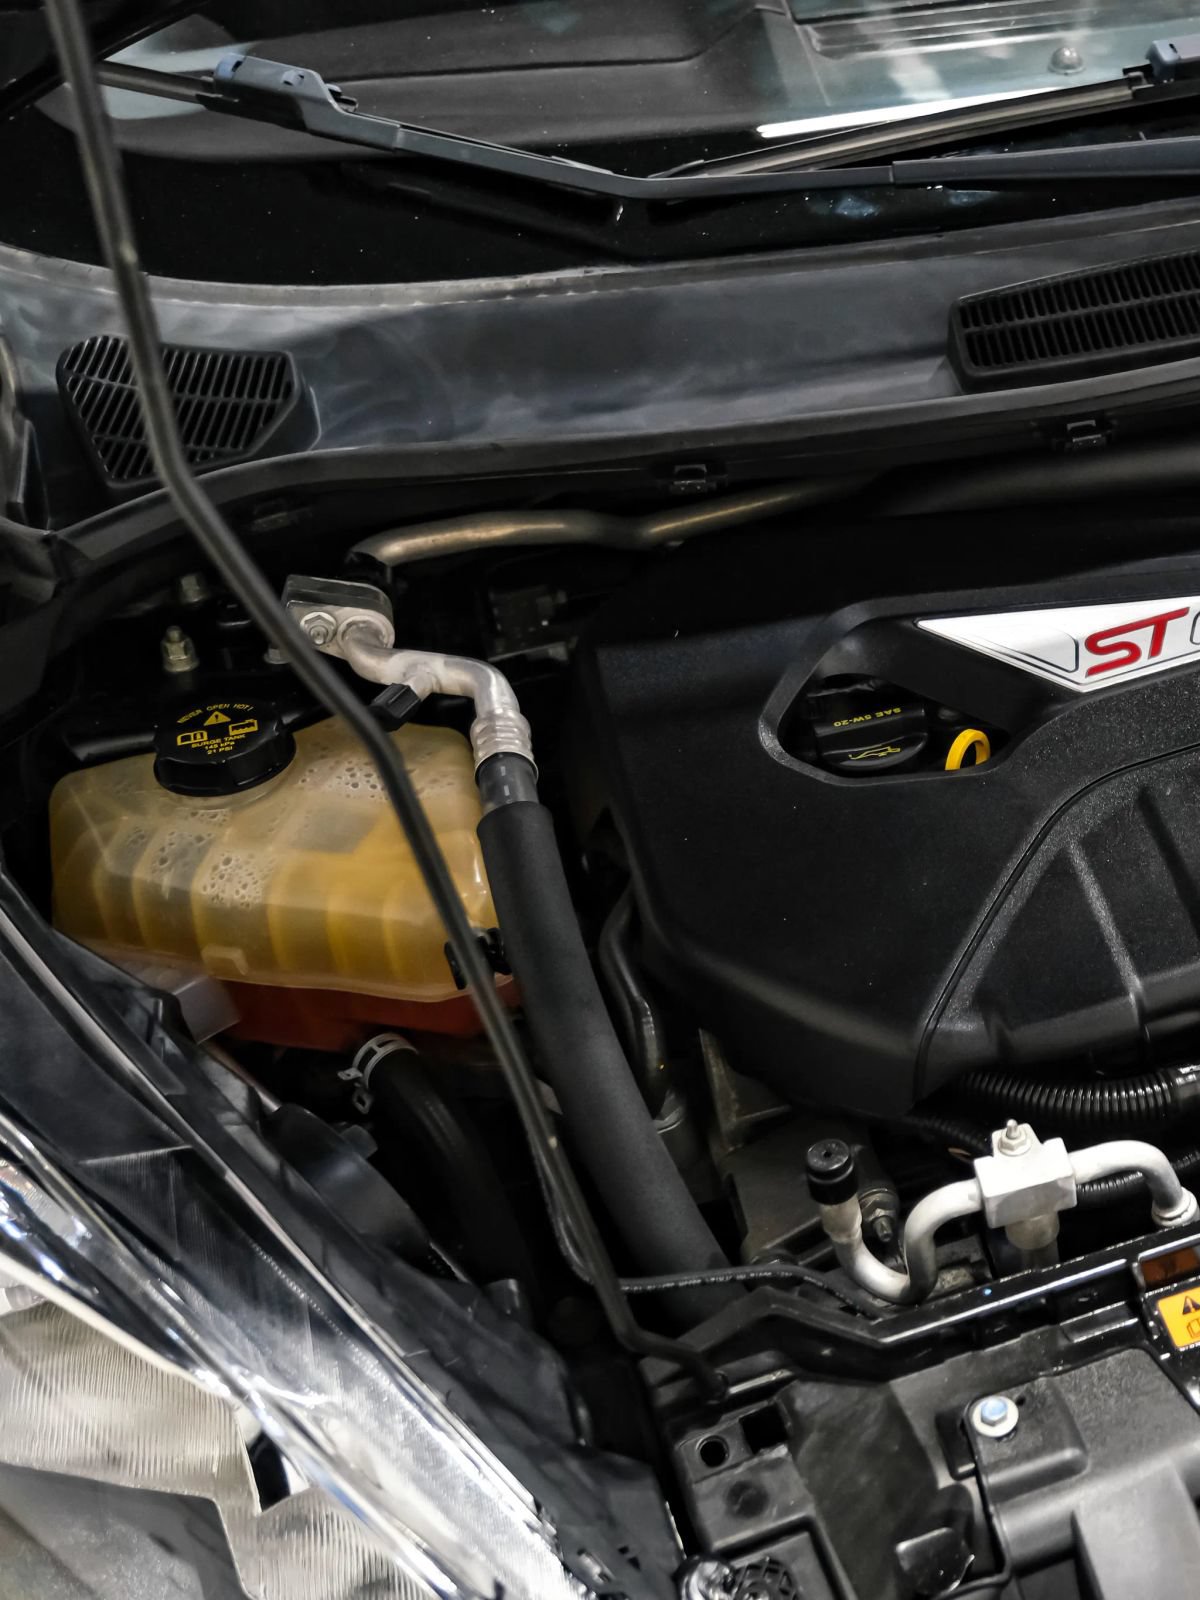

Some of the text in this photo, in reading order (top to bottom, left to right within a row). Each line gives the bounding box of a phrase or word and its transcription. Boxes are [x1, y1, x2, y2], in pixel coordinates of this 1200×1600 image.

[1085, 606, 1190, 678] ST
[206, 703, 230, 711] OPEN
[233, 703, 254, 711] HOT!
[833, 707, 902, 727] SAE 5W-20
[191, 738, 222, 748] SURGE
